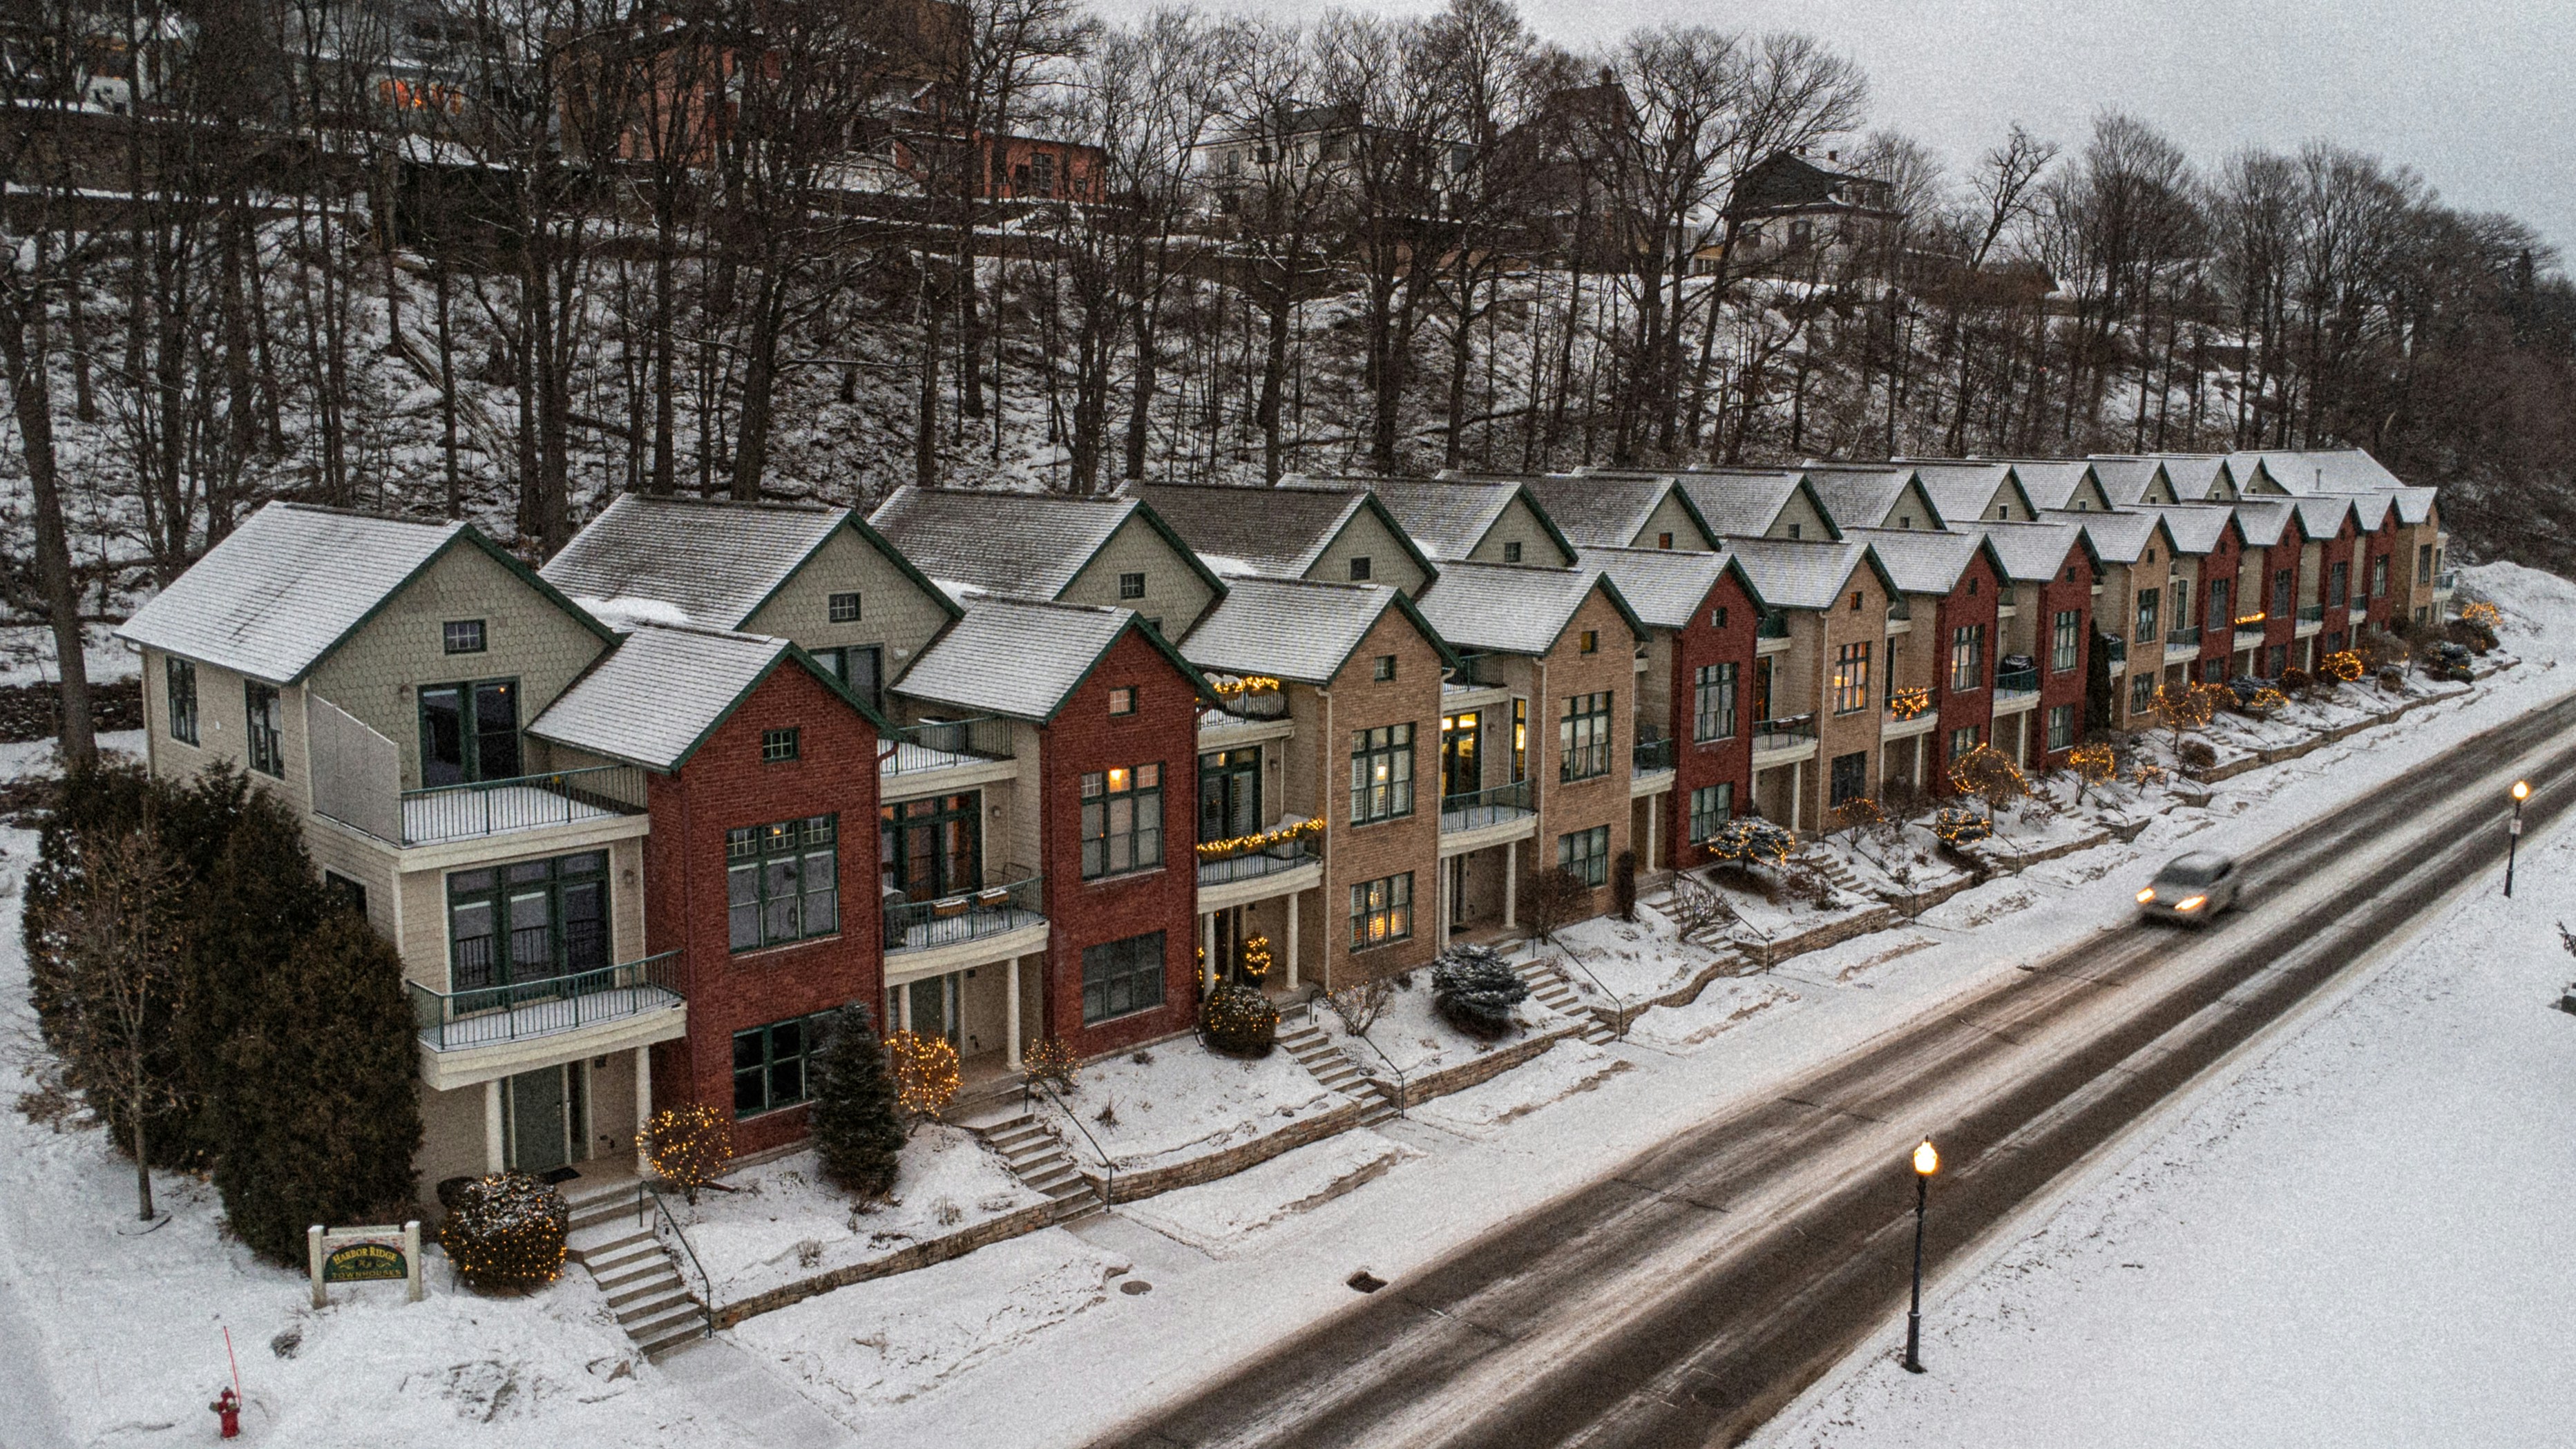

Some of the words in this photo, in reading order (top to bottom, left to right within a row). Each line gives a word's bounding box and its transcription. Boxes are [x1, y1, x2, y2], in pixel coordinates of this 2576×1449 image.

[332, 1248, 368, 1265] HARBOR
[370, 1246, 397, 1262] RIDGE
[332, 1269, 401, 1278] TOWNHOUSES
